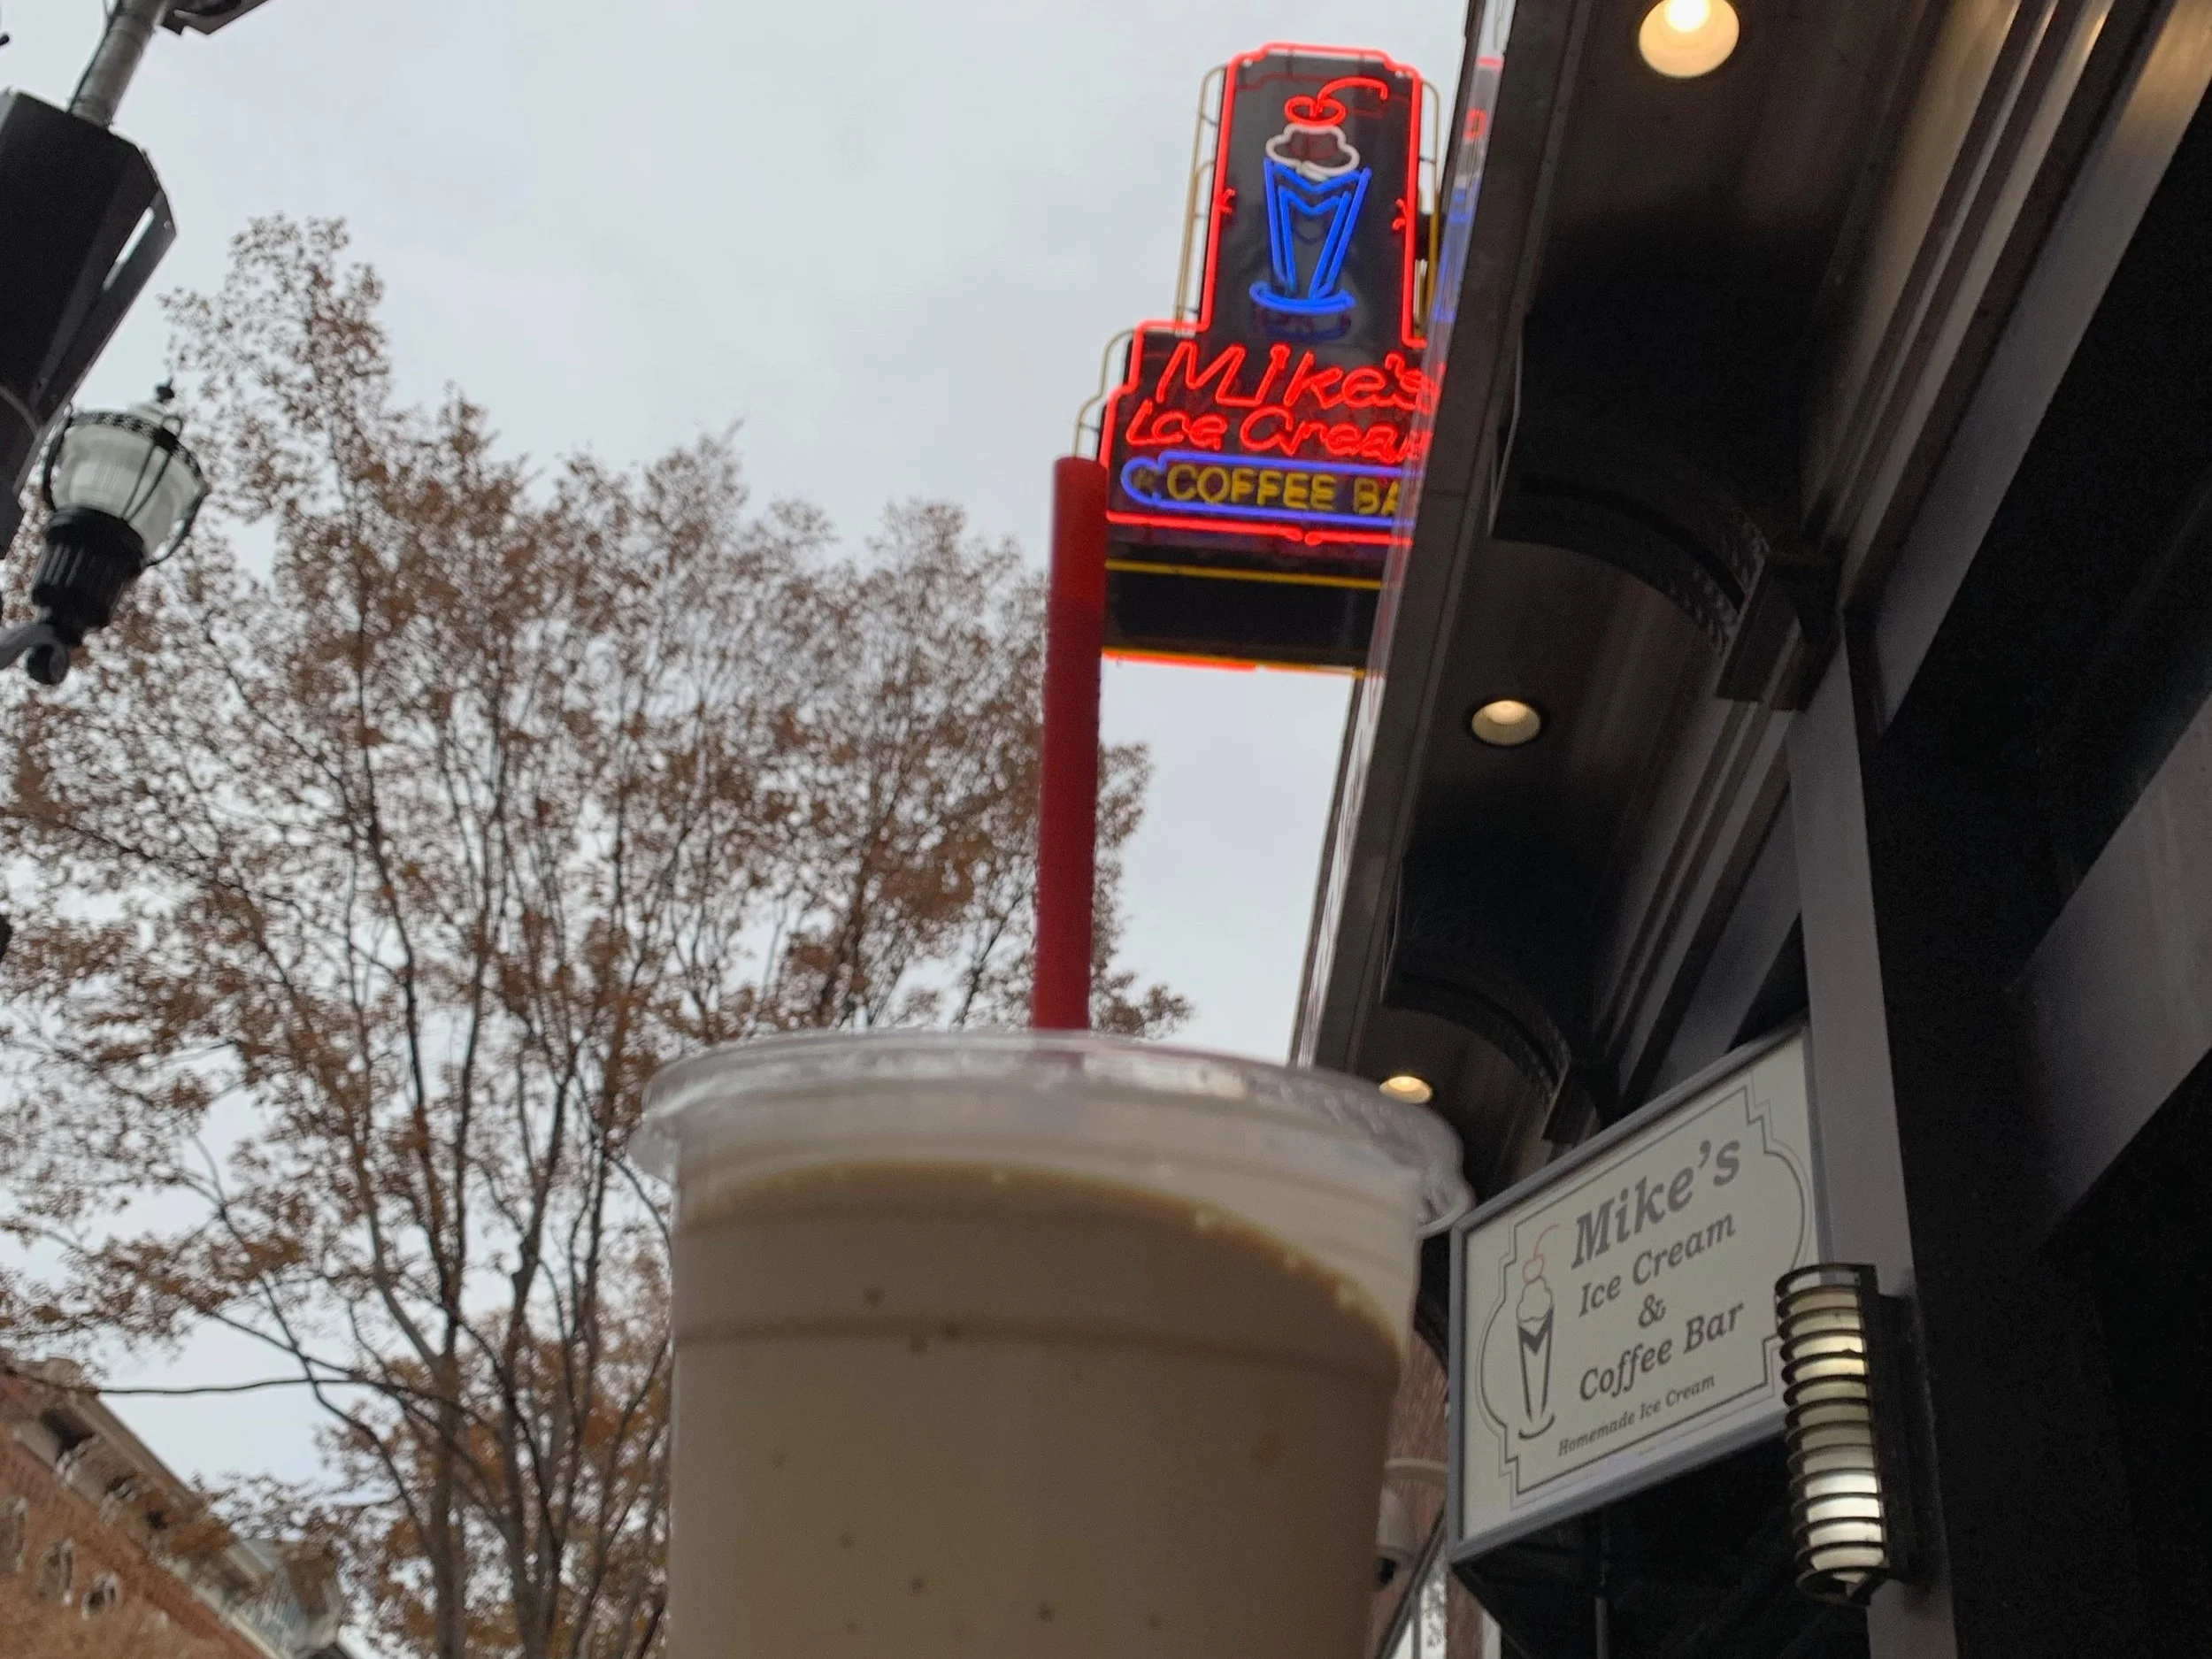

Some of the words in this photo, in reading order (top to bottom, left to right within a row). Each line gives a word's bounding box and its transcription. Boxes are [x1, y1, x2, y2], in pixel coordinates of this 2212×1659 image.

[1156, 340, 1433, 410] Mike's
[1166, 463, 1337, 513] COFFEE
[1353, 476, 1402, 516] BA
[1571, 1139, 1741, 1271] Mike's
[1578, 1274, 1622, 1318] Ice
[1632, 1213, 1737, 1286] Cream
[1579, 1337, 1673, 1402] Coffee
[1684, 1302, 1745, 1356] Bar
[1638, 1293, 1667, 1328] &
[1557, 1409, 1636, 1458] Homemade
[1640, 1396, 1662, 1421] Ice
[1666, 1373, 1717, 1409] Cream
